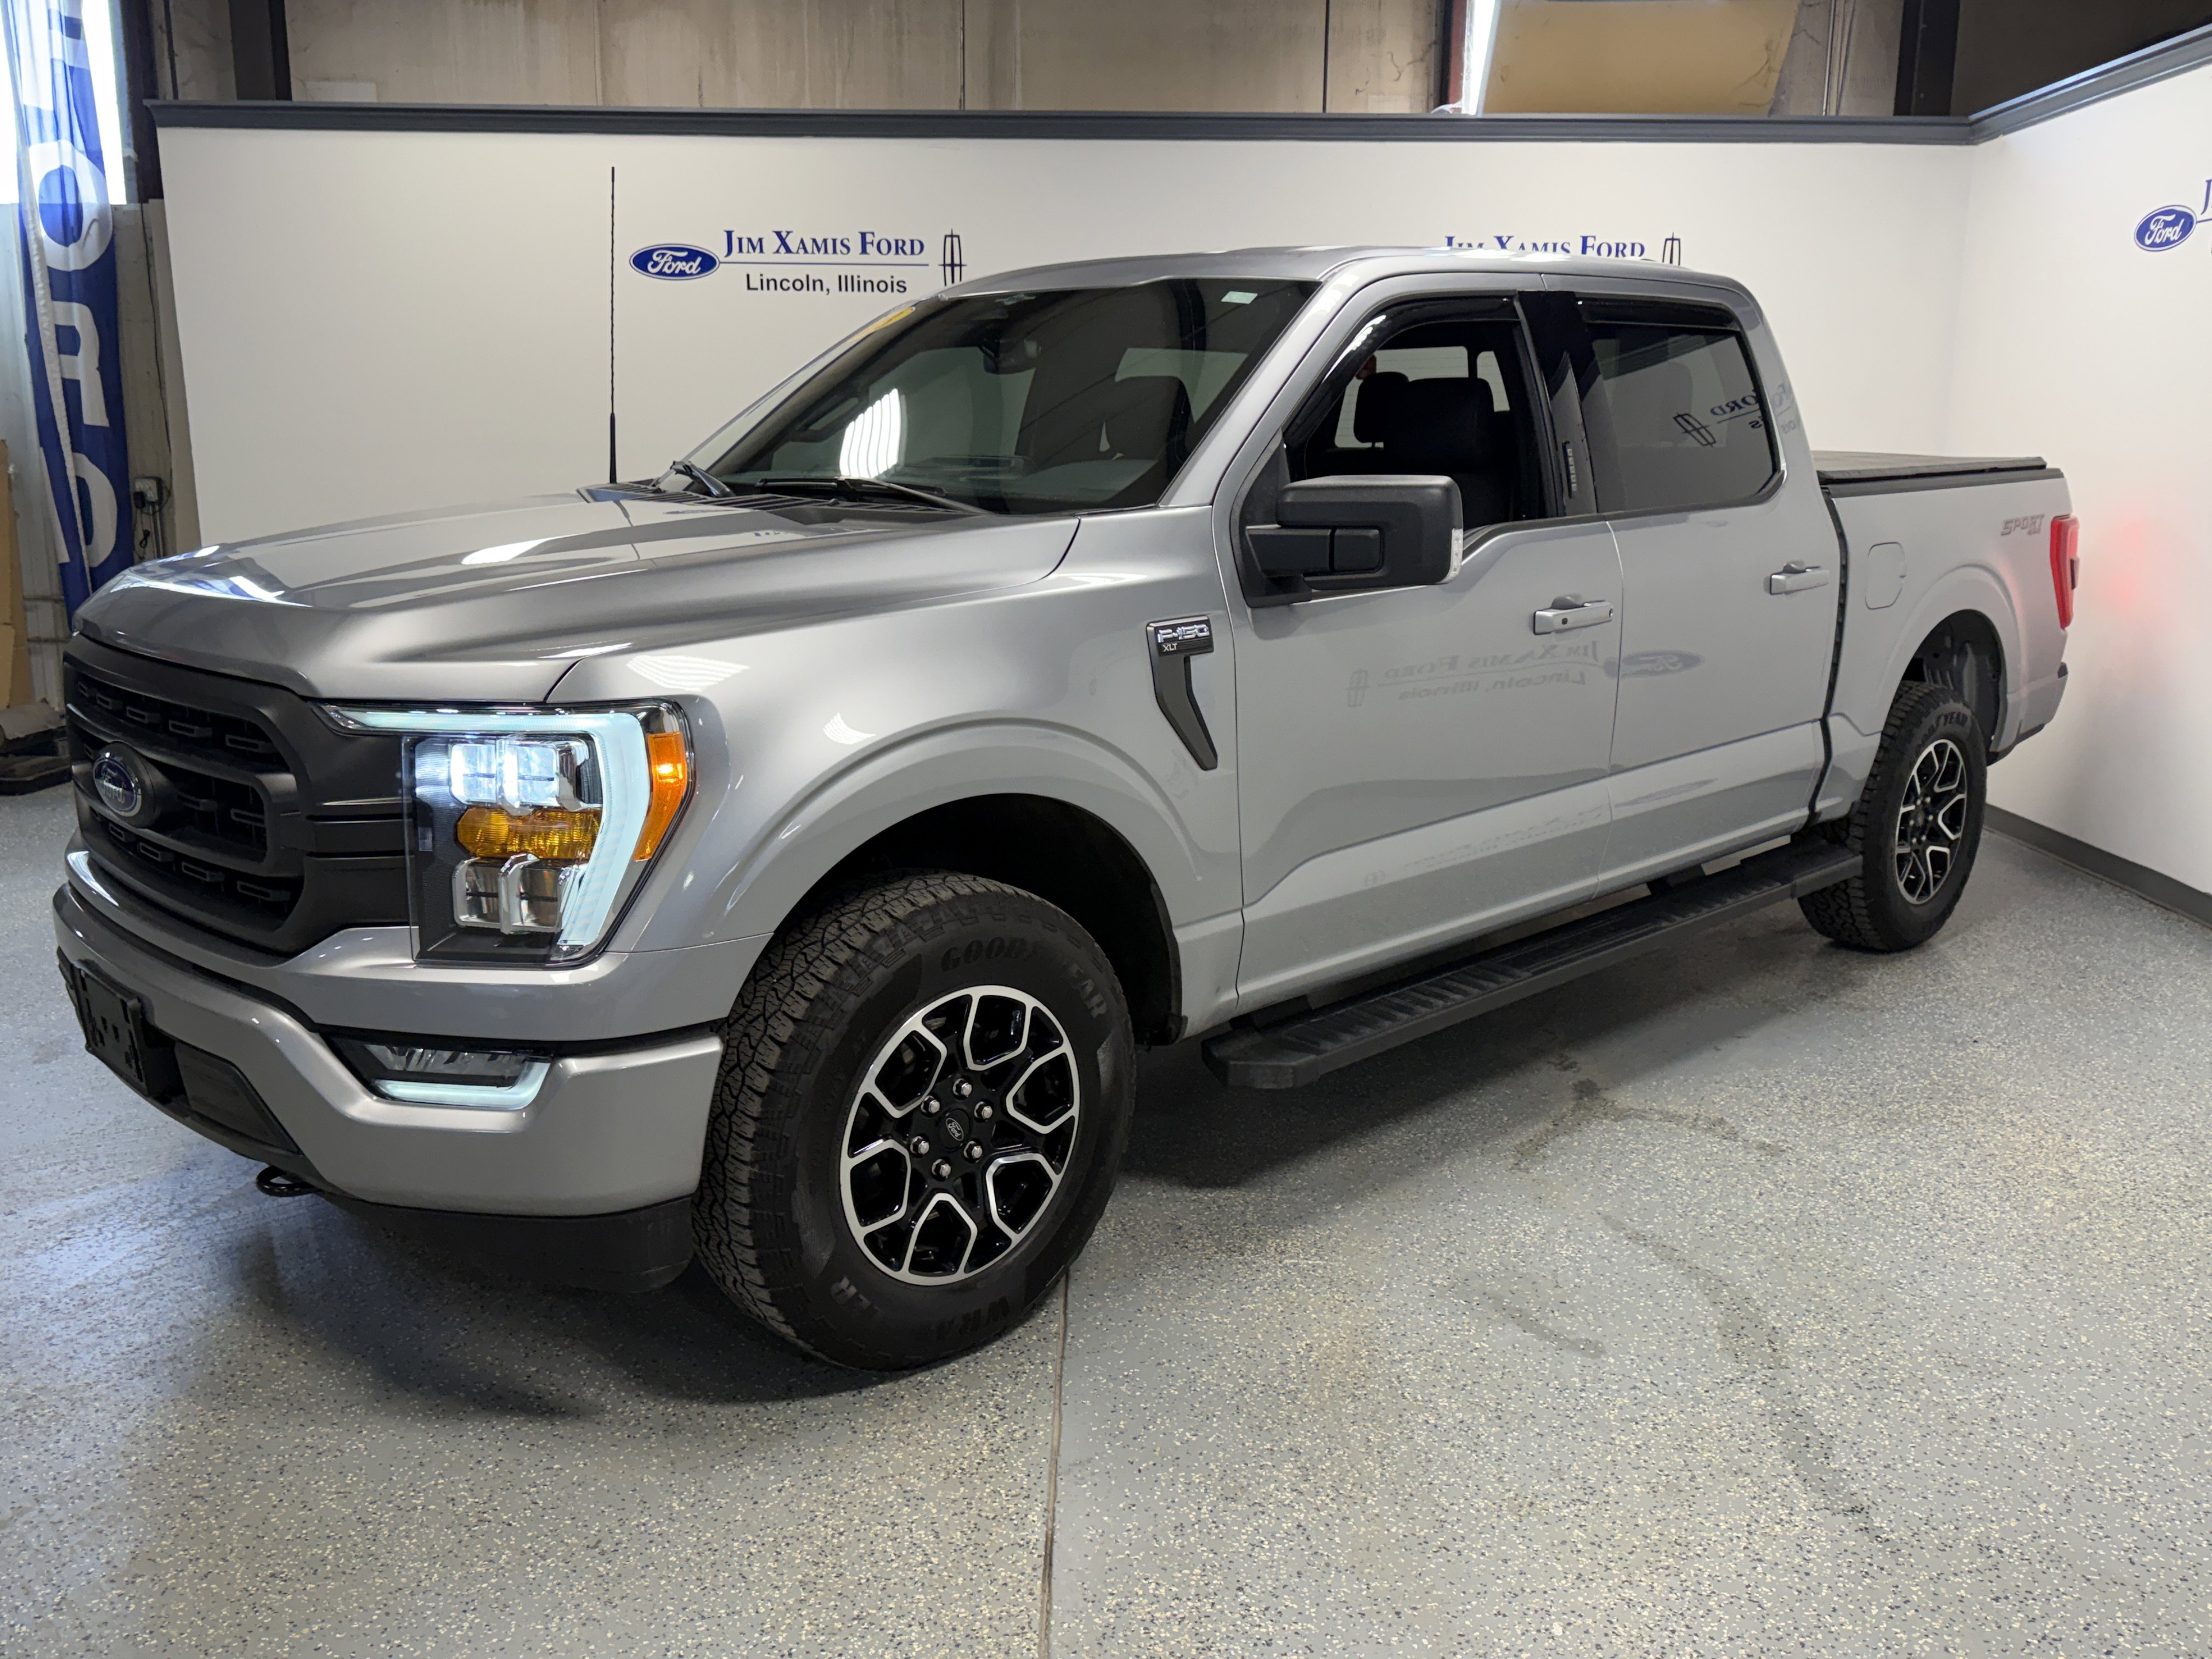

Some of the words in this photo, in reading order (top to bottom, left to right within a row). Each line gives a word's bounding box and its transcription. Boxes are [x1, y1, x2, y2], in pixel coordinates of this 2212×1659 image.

[2145, 213, 2185, 246] Ford
[724, 230, 764, 257] JIM
[772, 230, 851, 256] XAMIS
[858, 231, 925, 256] FORD
[647, 249, 702, 275] Ford
[746, 273, 830, 295] Lincoln,
[838, 275, 907, 294] Illinois
[1163, 642, 1178, 652] XLT
[940, 936, 1108, 1019] GOODEAR
[948, 1121, 962, 1138] Ford
